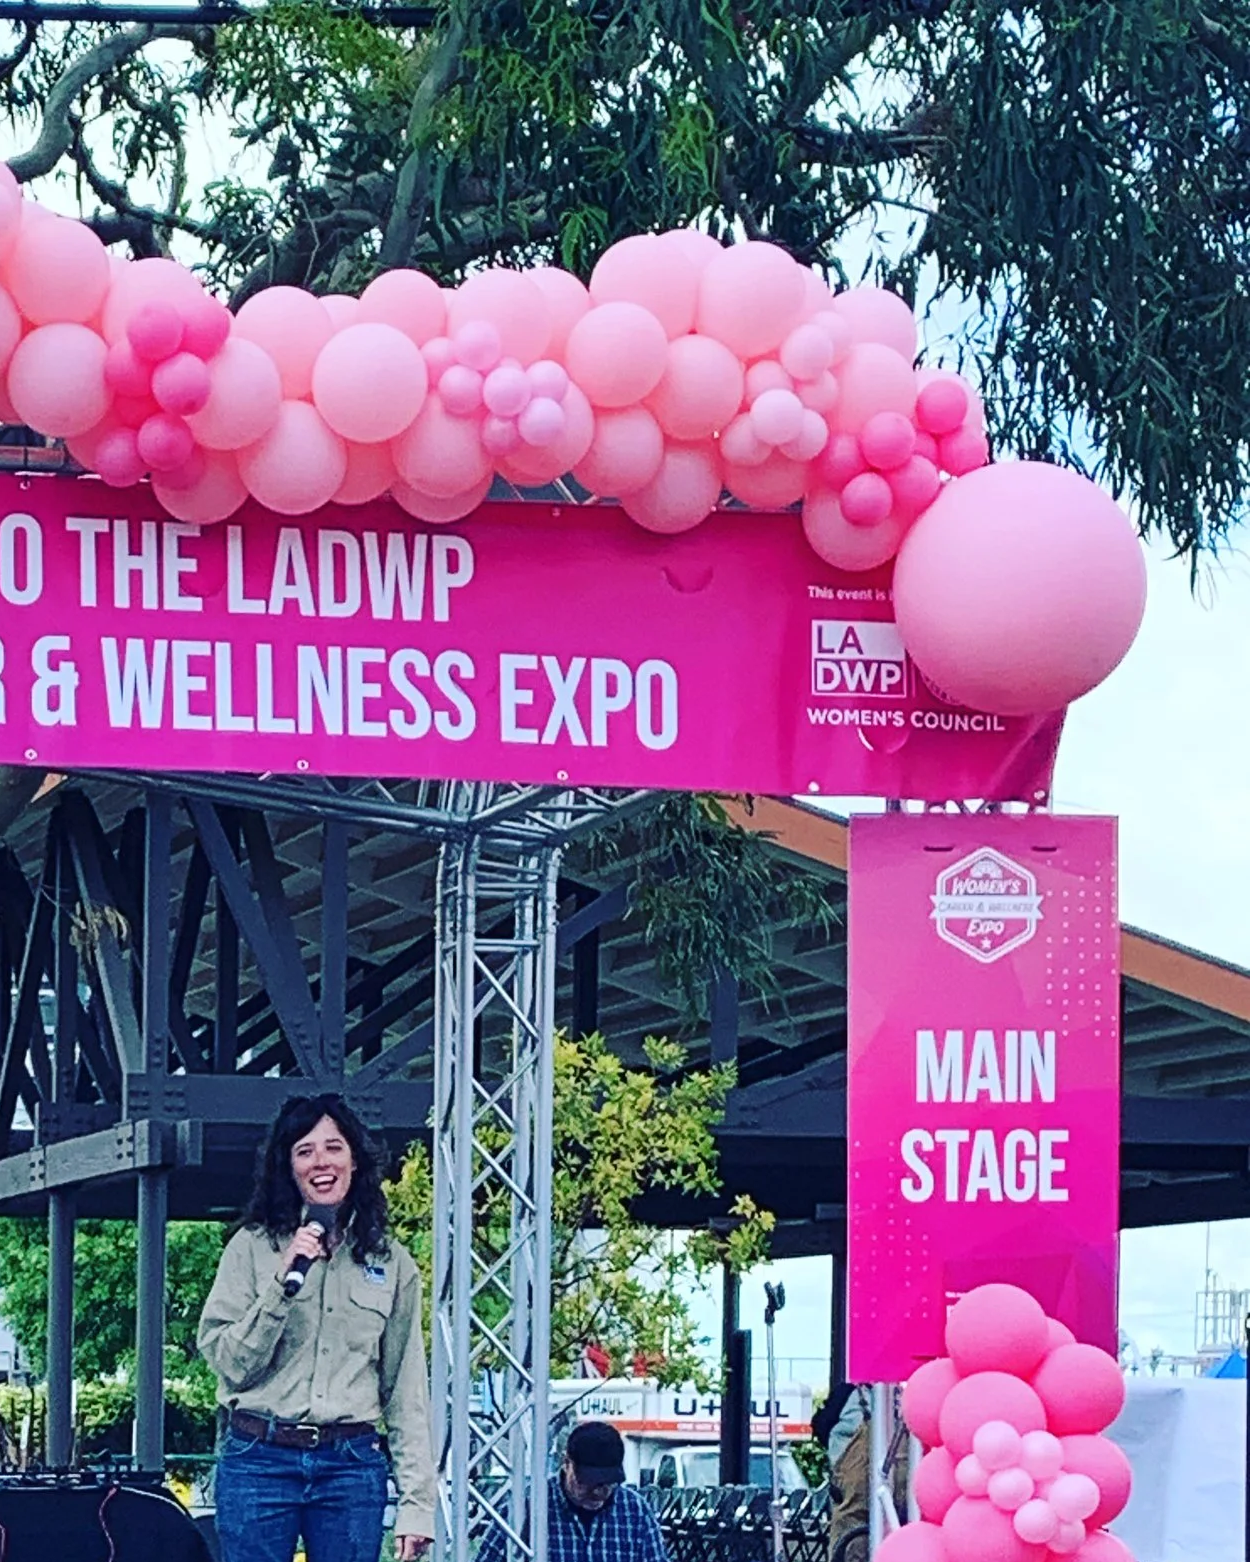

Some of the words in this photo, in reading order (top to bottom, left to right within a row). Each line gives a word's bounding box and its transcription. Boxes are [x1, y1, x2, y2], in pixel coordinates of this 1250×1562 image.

[67, 519, 203, 612] THE
[227, 528, 474, 622] LADWP
[808, 586, 834, 599] This
[837, 588, 873, 600] event
[875, 589, 886, 601] is
[817, 625, 864, 655] LA
[32, 636, 78, 727] &
[101, 638, 476, 741] WELLNESS
[499, 654, 678, 750] EXPO
[816, 660, 902, 693] DWP
[807, 708, 905, 728] WOMEN'S
[910, 711, 1005, 732] COUNCIL
[952, 877, 1022, 896] WOMEN'S
[916, 1030, 1056, 1103] MAIN
[900, 1128, 1069, 1203] STAGE
